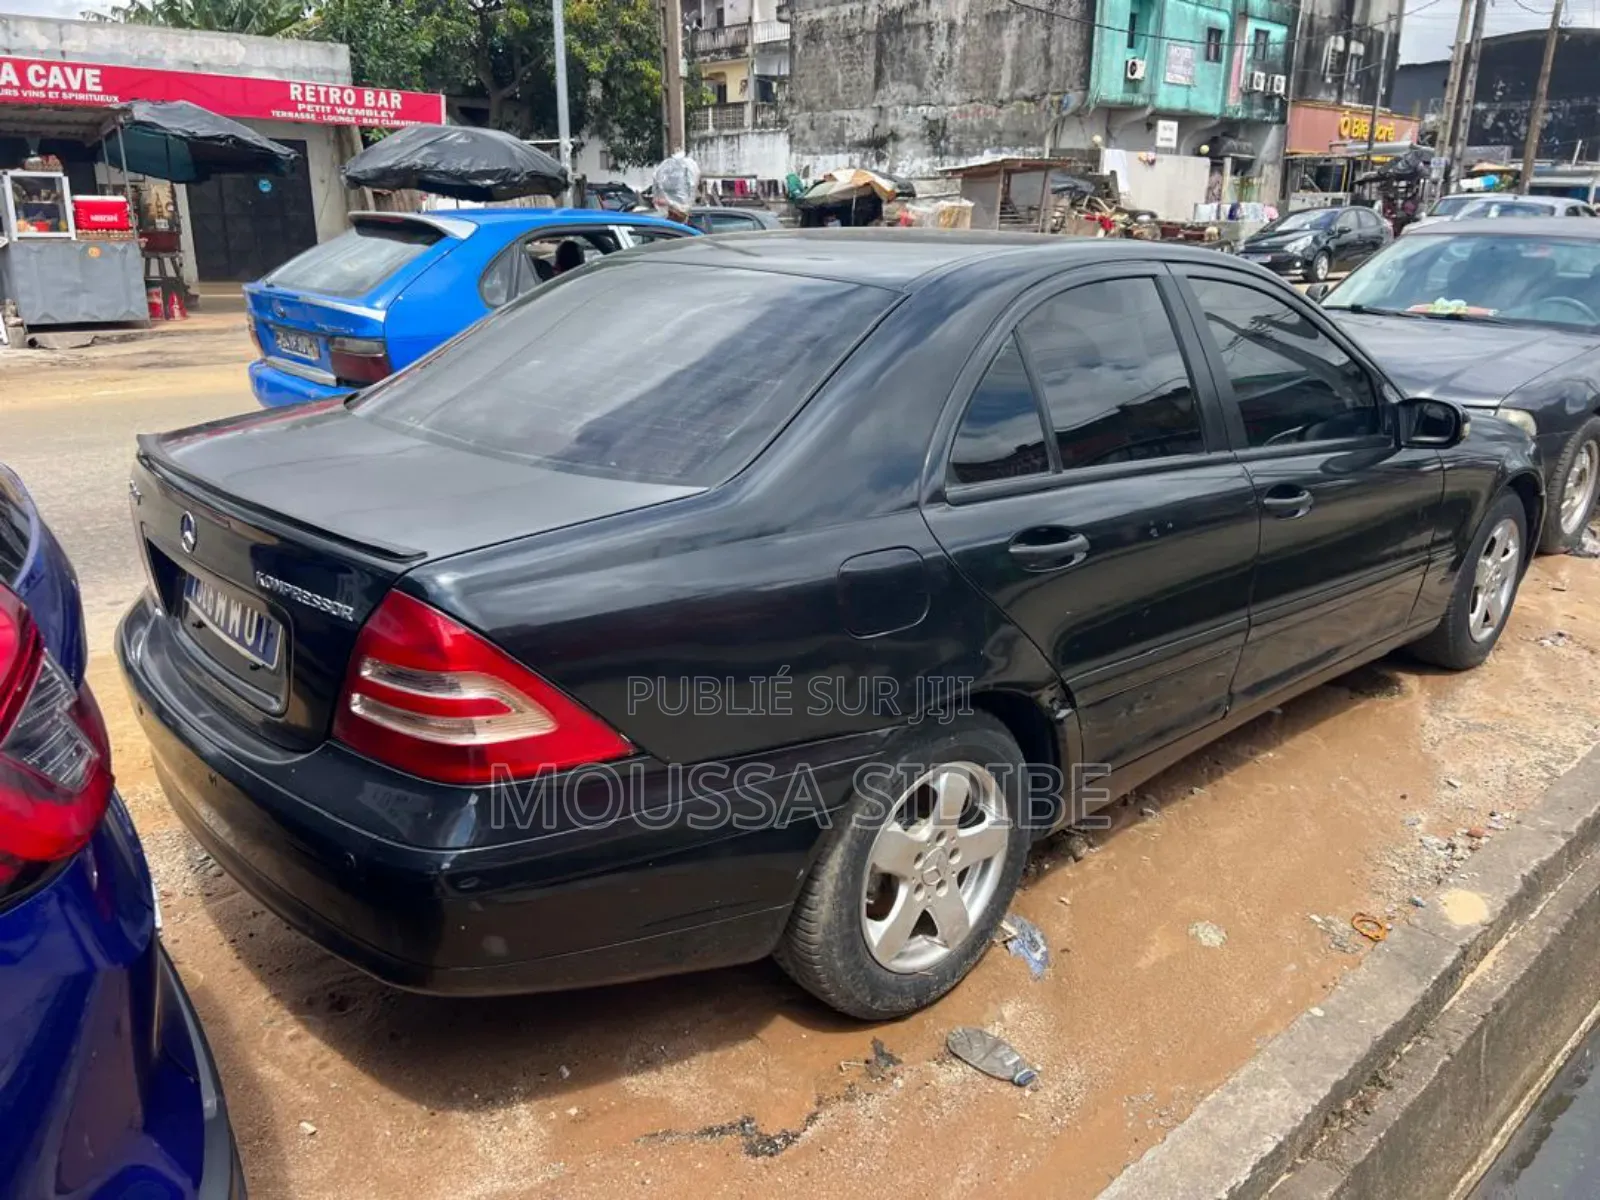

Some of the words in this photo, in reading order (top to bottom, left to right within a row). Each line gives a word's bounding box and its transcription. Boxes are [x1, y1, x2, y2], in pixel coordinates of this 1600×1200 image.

[0, 62, 20, 86] A
[27, 64, 103, 92] CAVE
[20, 90, 46, 99] VINS
[48, 91, 60, 99] ET
[61, 92, 119, 102] SPIRITUEUX
[289, 84, 356, 105] RETRO
[364, 90, 402, 109] BAR
[271, 110, 316, 121] TERRASSE
[323, 115, 356, 124] LOUNGE
[362, 117, 380, 125] BAR
[297, 103, 332, 114] PETIT
[335, 106, 396, 118] WEMBLEY
[255, 570, 354, 622] KOMPRESSOR
